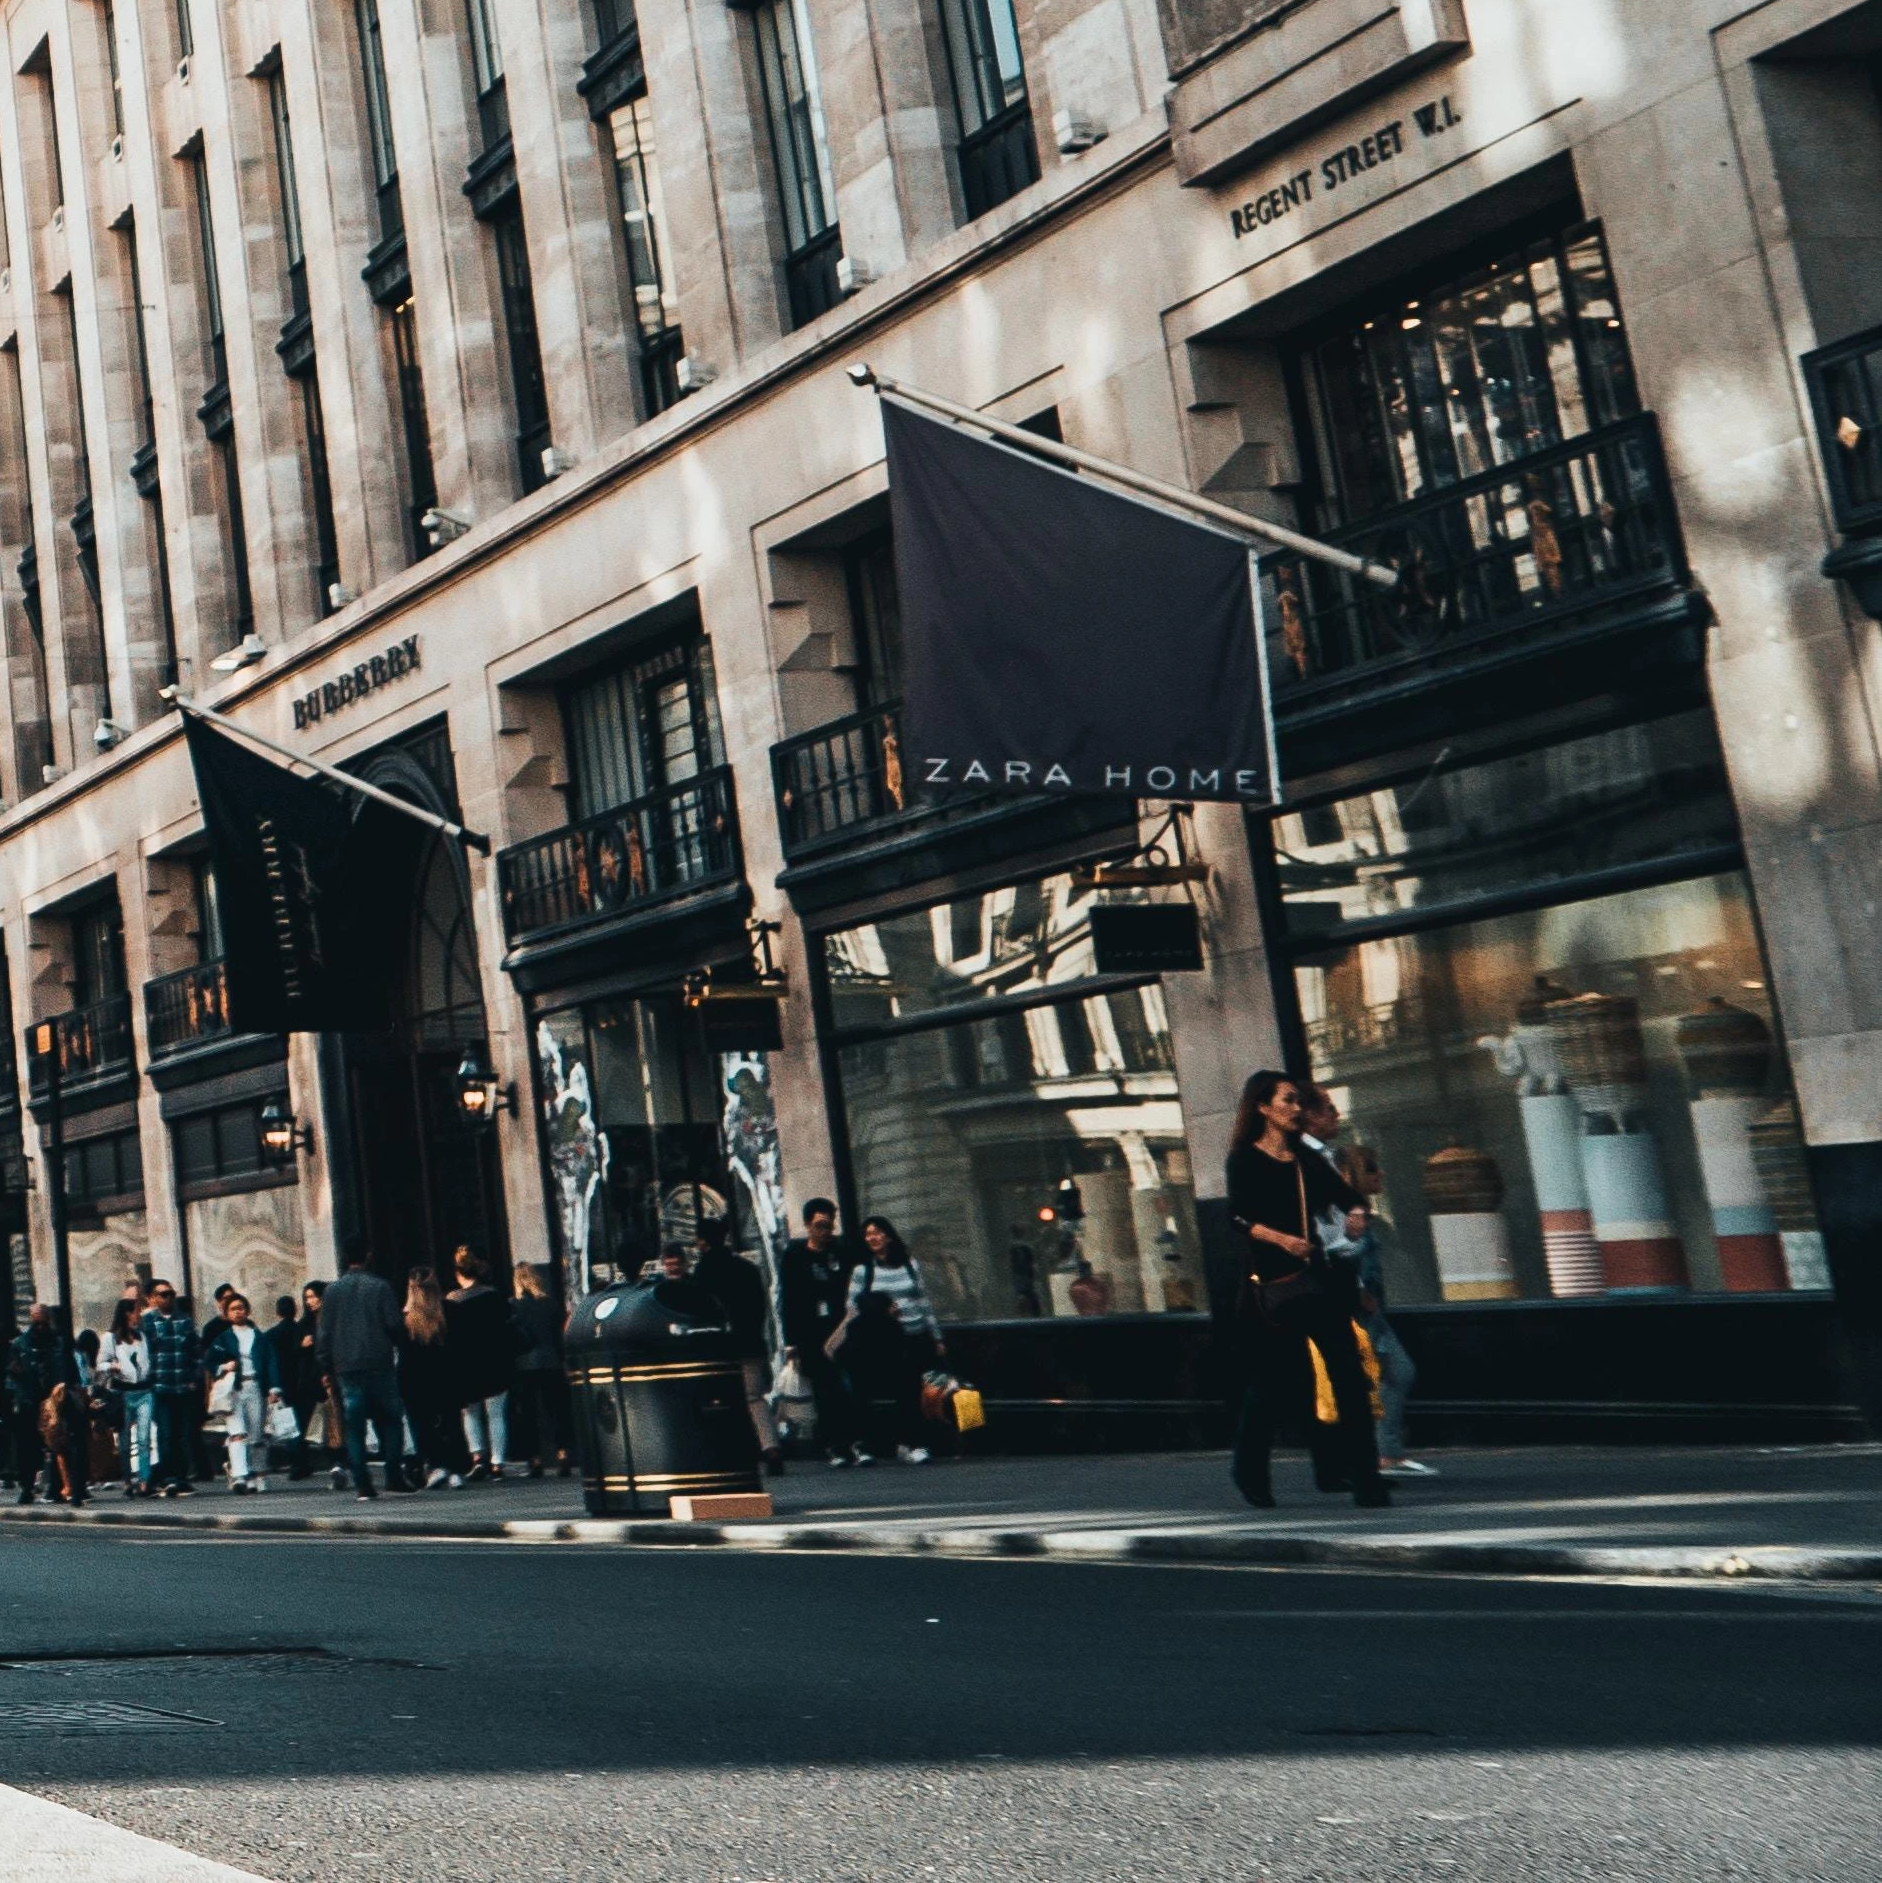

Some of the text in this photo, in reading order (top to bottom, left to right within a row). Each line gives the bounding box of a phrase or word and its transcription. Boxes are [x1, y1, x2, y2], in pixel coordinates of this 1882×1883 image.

[1229, 168, 1313, 240] REGENT
[1320, 119, 1404, 191] STREET
[292, 632, 422, 730] BURBERRY
[923, 757, 1261, 794] ZARA HOME
